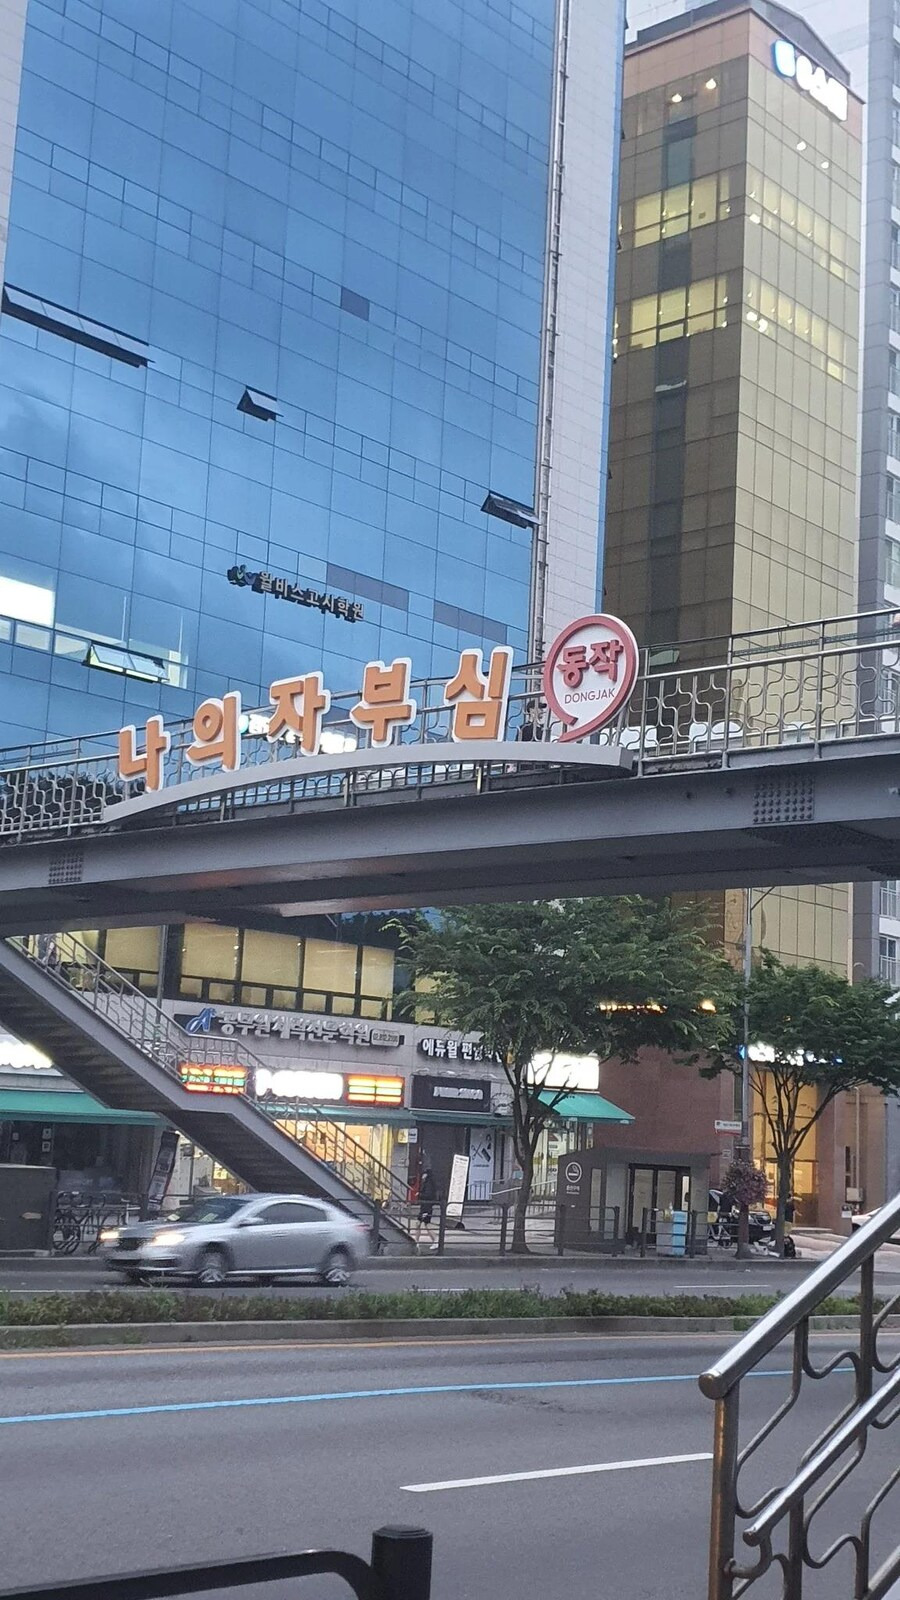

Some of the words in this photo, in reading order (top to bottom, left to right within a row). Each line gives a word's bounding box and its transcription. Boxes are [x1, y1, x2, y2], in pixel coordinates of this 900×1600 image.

[557, 640, 624, 688] 동작
[564, 688, 615, 704] DONGJAK
[422, 1038, 457, 1059] 에듀윌
